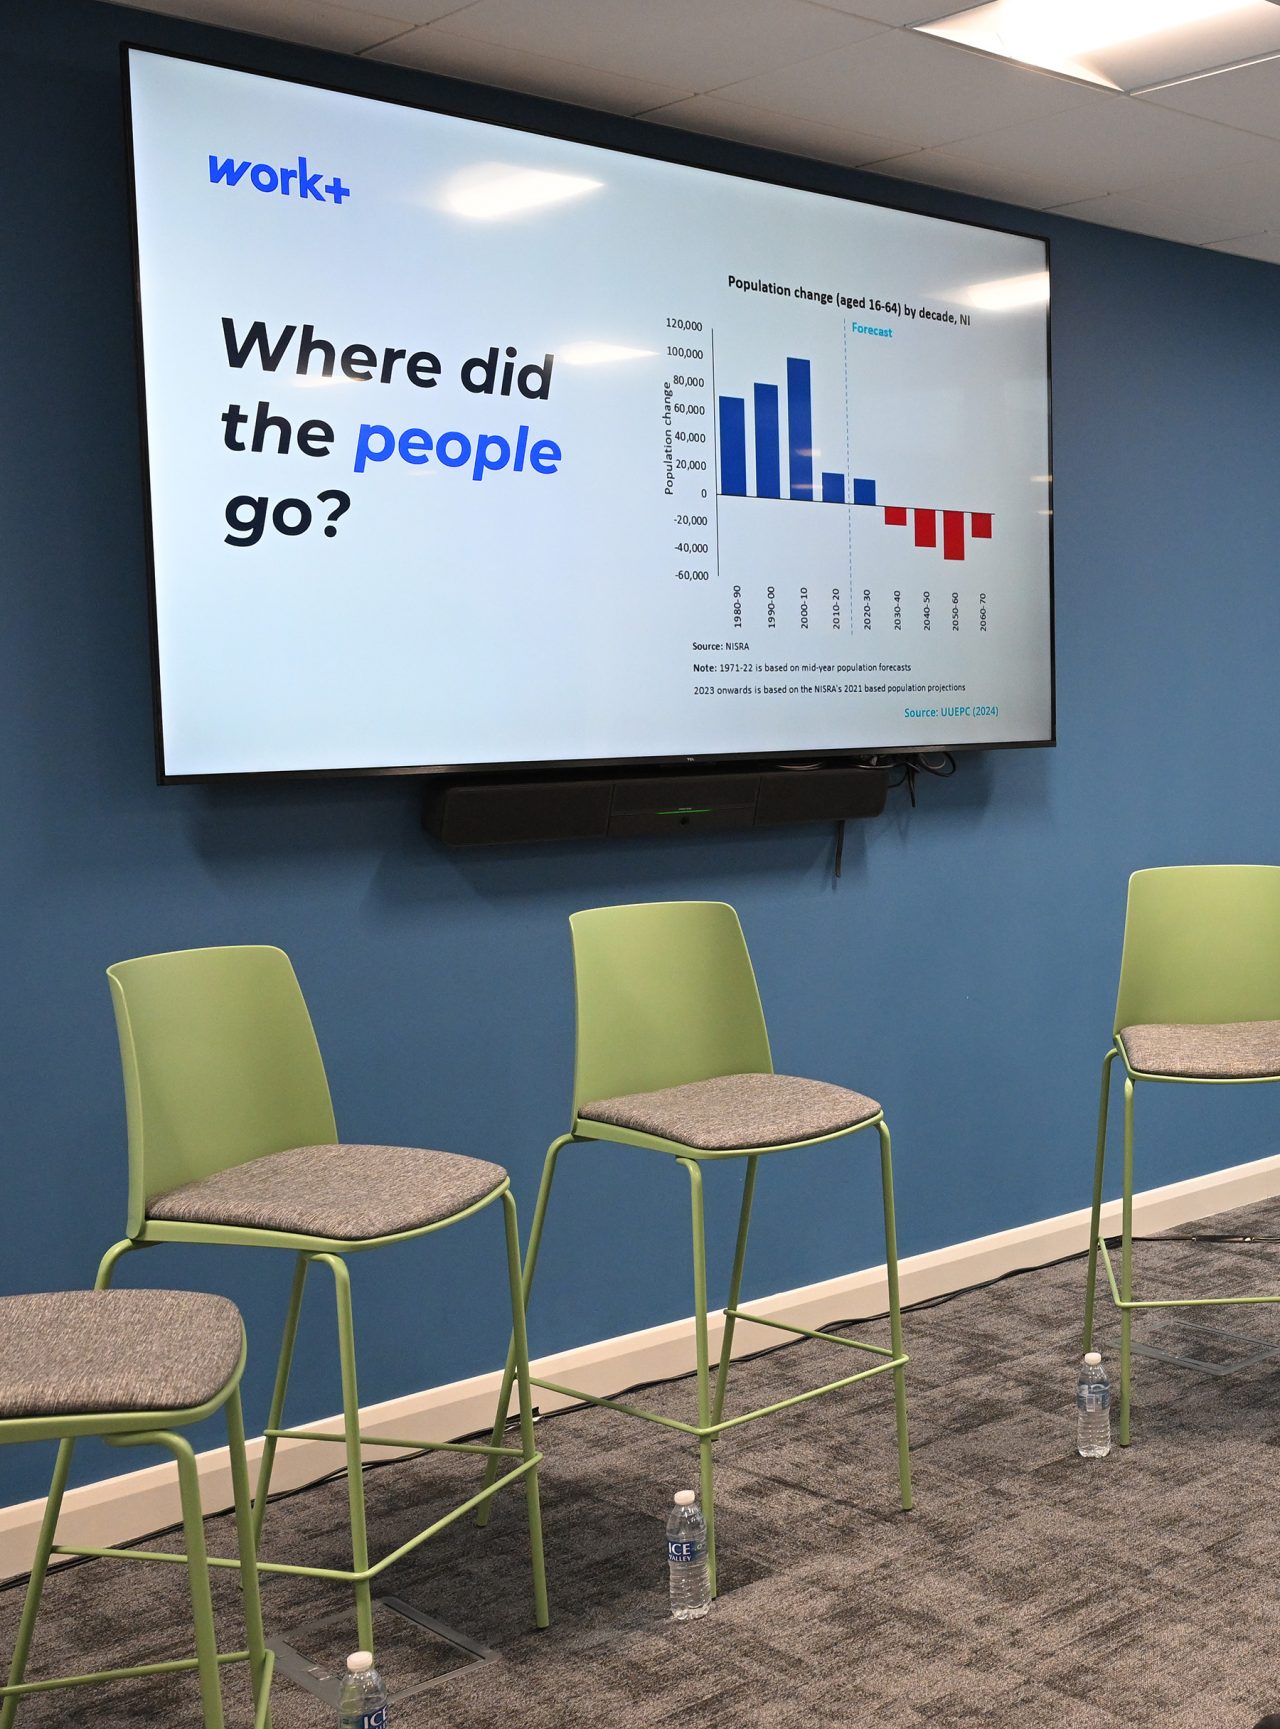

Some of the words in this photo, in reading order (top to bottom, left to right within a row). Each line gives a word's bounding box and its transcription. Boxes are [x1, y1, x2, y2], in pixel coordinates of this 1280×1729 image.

[728, 275, 791, 297] Population
[794, 286, 833, 305] change
[836, 292, 866, 309] (aged
[869, 299, 901, 317] 16-64)
[904, 304, 917, 319] by
[918, 307, 957, 325] decade,
[959, 314, 971, 326] NI
[666, 317, 703, 332] 120,000
[852, 322, 893, 338] Forecast
[221, 317, 442, 389] Where
[460, 346, 555, 400] did
[666, 346, 704, 360] 100,000
[673, 375, 705, 388] 80,000
[661, 381, 674, 426] change
[673, 403, 706, 416] 60,000
[221, 401, 335, 458] the
[353, 423, 562, 481] people
[674, 431, 707, 443] 40,000
[663, 429, 675, 496] Population
[675, 459, 707, 471] 20,000
[701, 489, 707, 499] 0
[223, 489, 351, 547] go?
[673, 515, 708, 526] -20,000
[674, 543, 709, 554] -40,000
[675, 571, 709, 581] -60,000
[733, 585, 742, 629] 1980-90
[767, 586, 776, 629] 1990-00
[800, 587, 809, 629] 2000-10
[832, 588, 841, 630] 2010-20
[863, 589, 872, 631] 2020-30
[894, 590, 902, 631] 2030-40
[923, 591, 931, 631] 2040-50
[952, 592, 960, 632] 2050-60
[692, 642, 724, 651] Source:
[725, 642, 750, 651] NISRA
[693, 664, 717, 673] Note:
[719, 664, 753, 673] 1971-22
[755, 664, 763, 673] is
[764, 662, 788, 672] based
[801, 663, 835, 674] mid-year
[836, 663, 878, 673] population
[878, 662, 912, 672] forecasts
[694, 687, 715, 695] 2023
[716, 685, 752, 694] onwards
[754, 685, 762, 694] is
[763, 685, 787, 694] based
[800, 684, 813, 694] the
[814, 685, 842, 693] NISRA's
[844, 684, 862, 692] 2021
[864, 684, 886, 692] based
[887, 683, 926, 694] population
[927, 682, 966, 693] projections
[904, 708, 939, 717] Source:
[941, 707, 970, 716] UUEPC
[972, 706, 999, 717] (2024)
[668, 1542, 690, 1555] ICE
